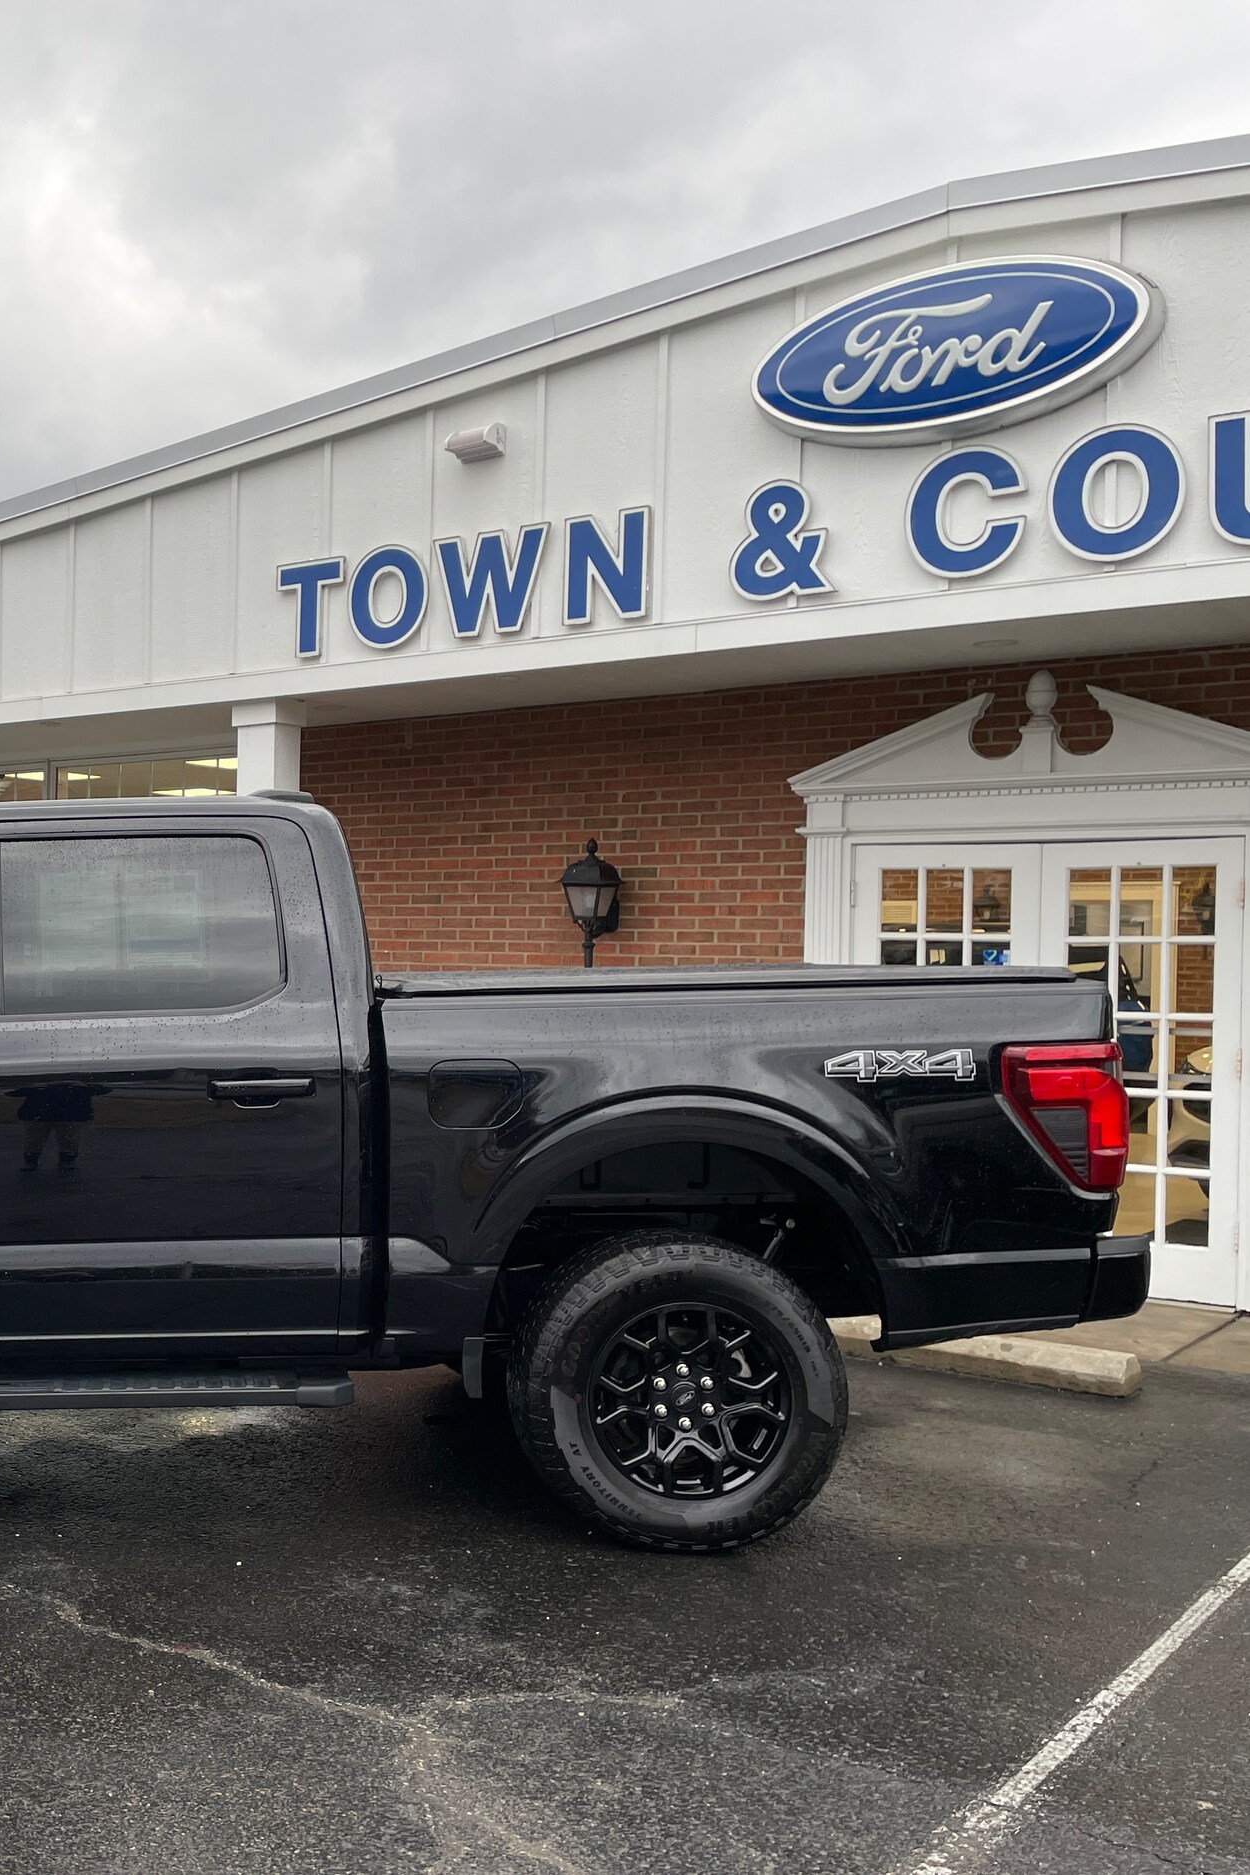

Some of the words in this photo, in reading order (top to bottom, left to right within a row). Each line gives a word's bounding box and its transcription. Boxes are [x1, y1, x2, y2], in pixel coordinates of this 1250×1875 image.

[822, 293, 1055, 406] Ford
[275, 505, 652, 659] TOWN
[729, 479, 838, 602] &
